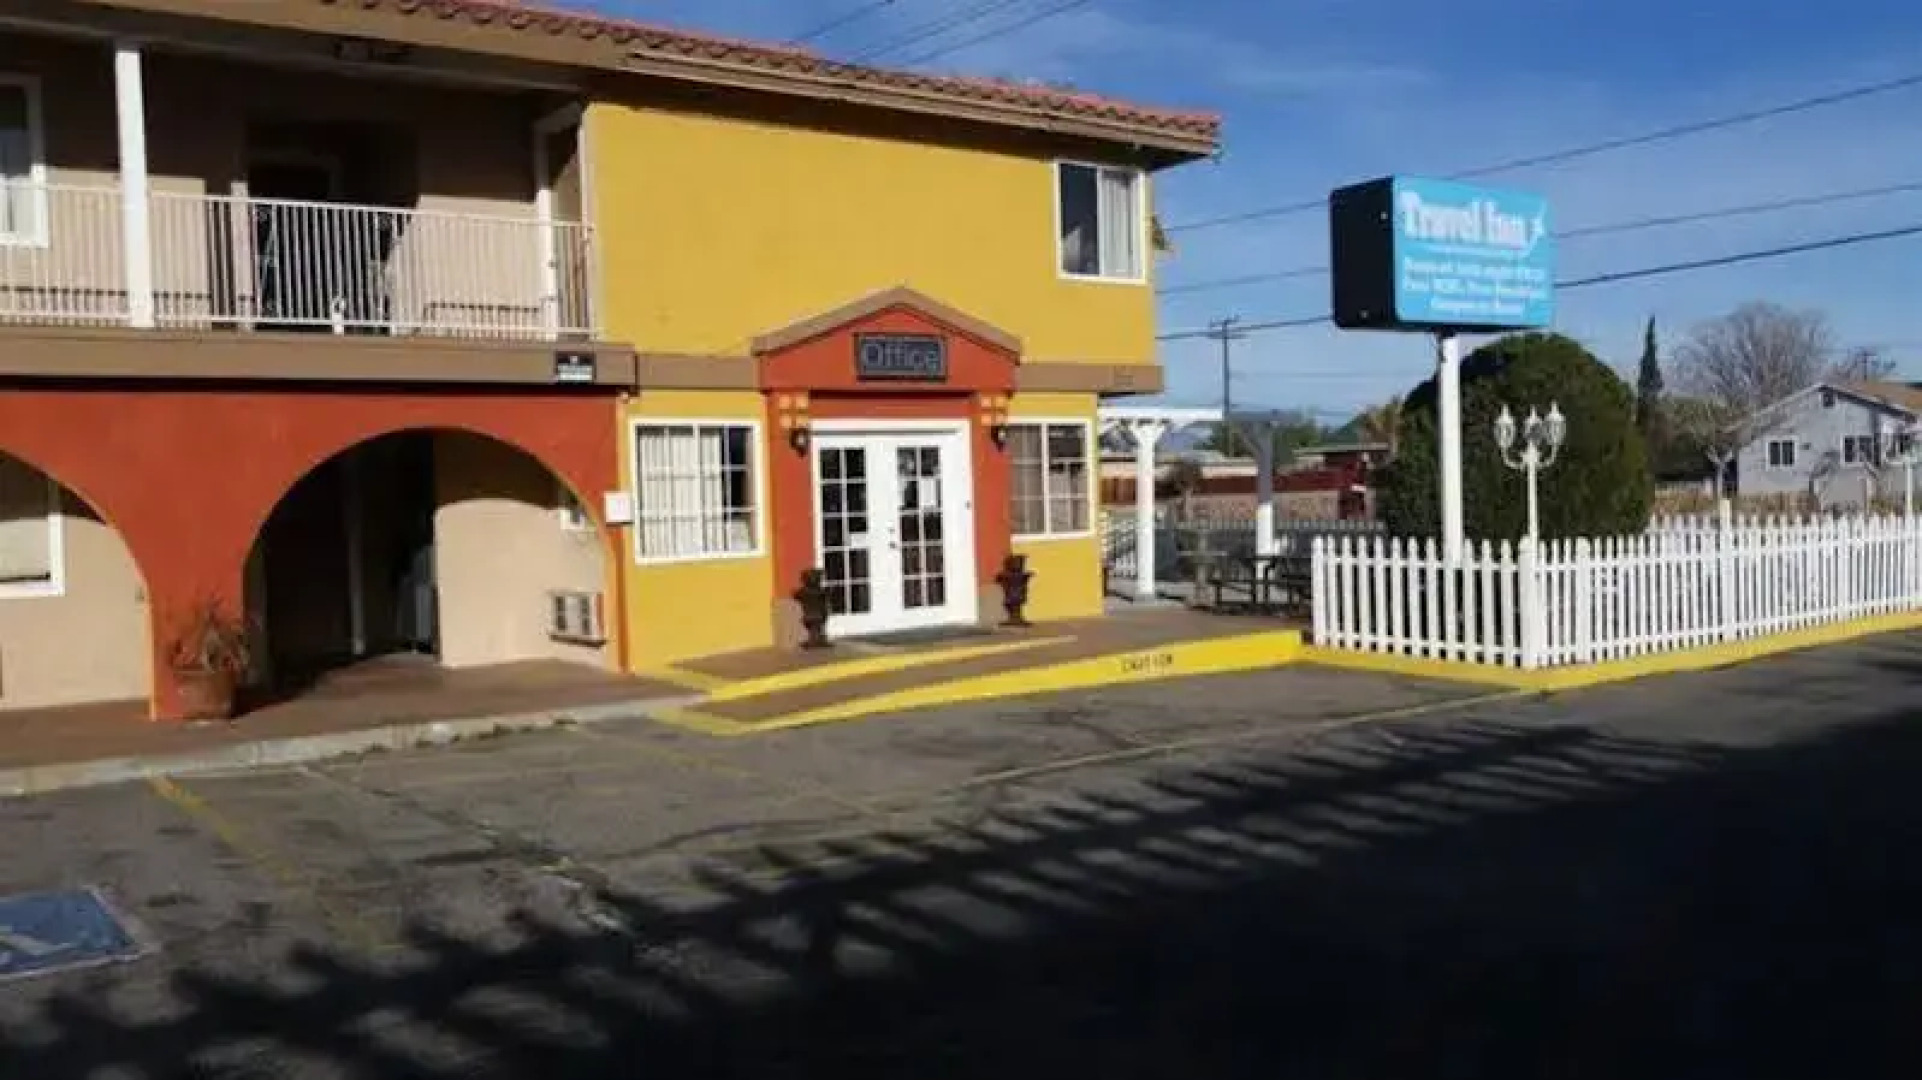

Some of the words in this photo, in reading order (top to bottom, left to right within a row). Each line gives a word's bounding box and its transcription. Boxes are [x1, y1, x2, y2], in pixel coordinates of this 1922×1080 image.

[1401, 190, 1480, 244] Travel
[1484, 200, 1525, 246] Inn
[861, 341, 939, 371] Office
